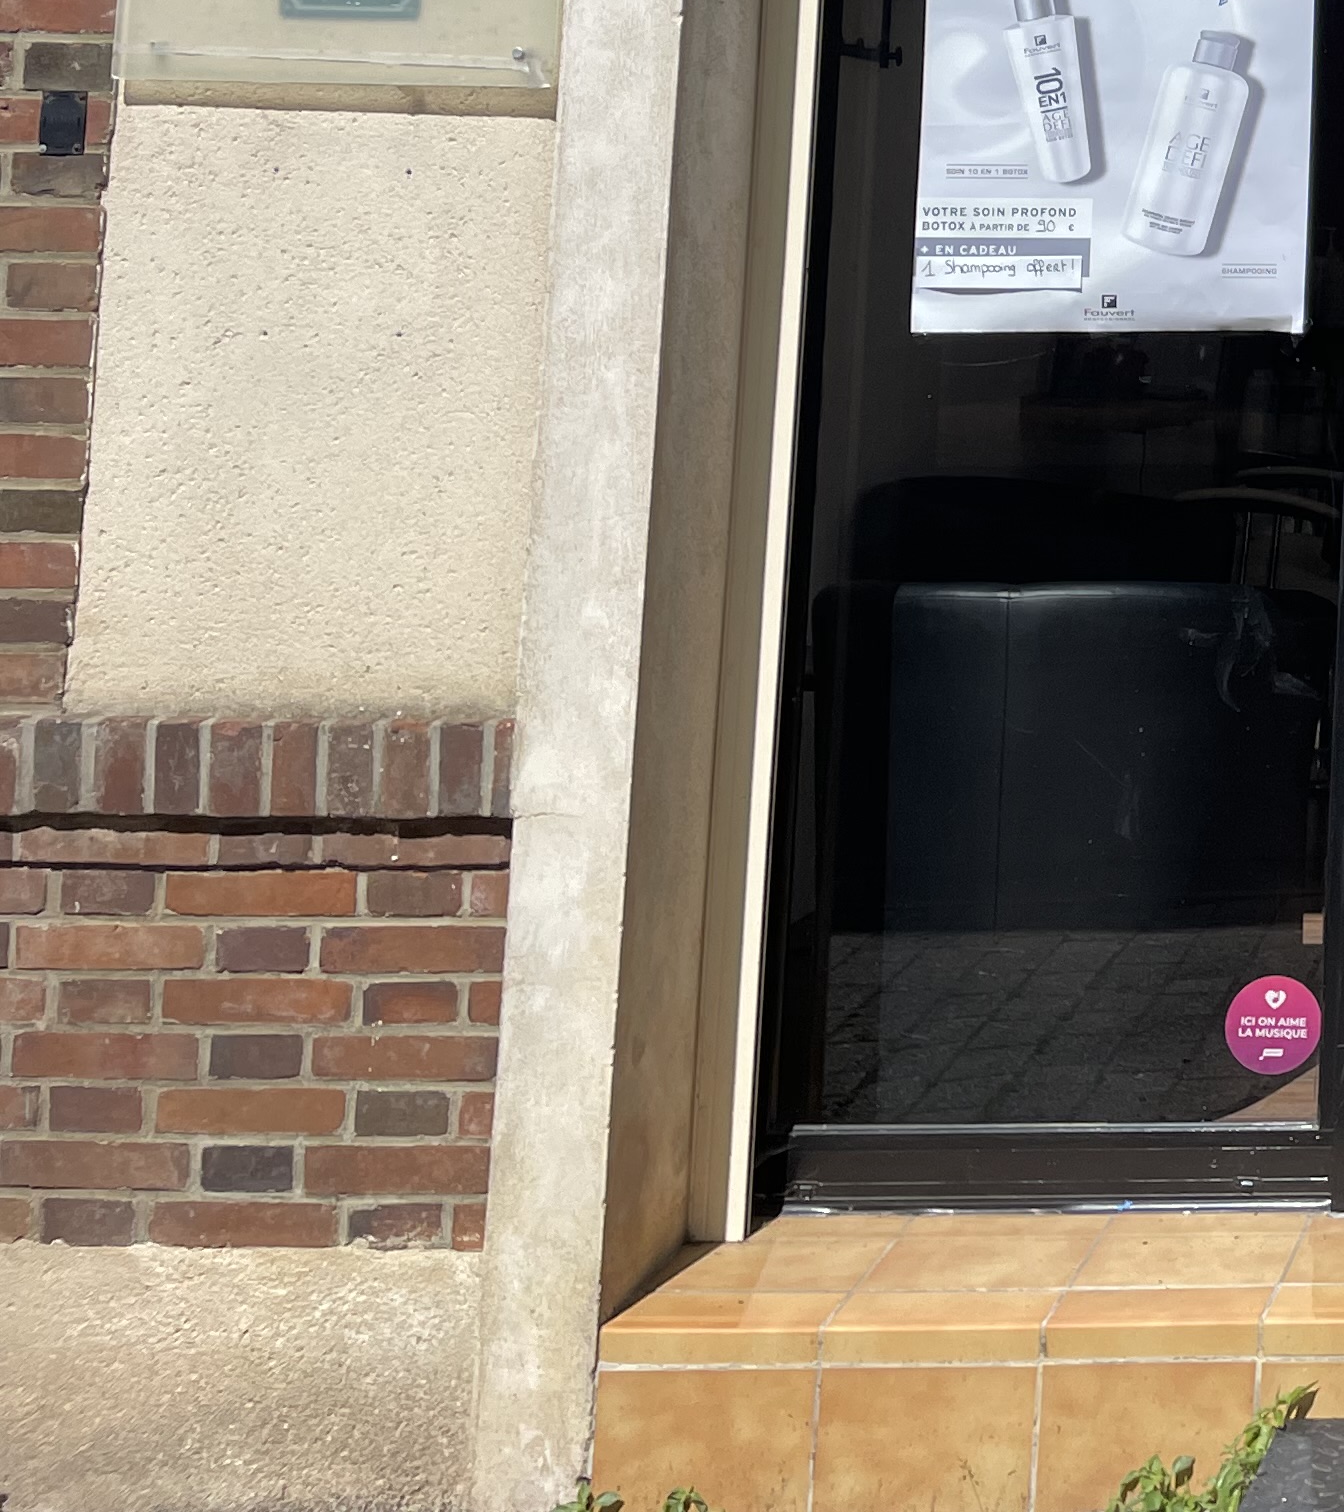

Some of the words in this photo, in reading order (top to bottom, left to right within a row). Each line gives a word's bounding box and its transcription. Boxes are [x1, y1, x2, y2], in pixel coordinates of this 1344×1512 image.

[922, 207, 967, 217] VOTRE
[973, 207, 1006, 217] SOIN
[1011, 207, 1077, 218] PROFOND
[922, 221, 965, 231] BOTOX
[979, 223, 1014, 232] PARTIR
[1017, 223, 1030, 232] DE
[935, 245, 954, 255] EN
[959, 245, 1017, 255] CADEAU
[1084, 308, 1135, 316] Fauvert
[1240, 1016, 1256, 1026] ICI
[1258, 1016, 1275, 1026] ON
[1277, 1017, 1307, 1027] AIME
[1238, 1028, 1252, 1037] LA
[1255, 1028, 1308, 1040] MUSIQUE
